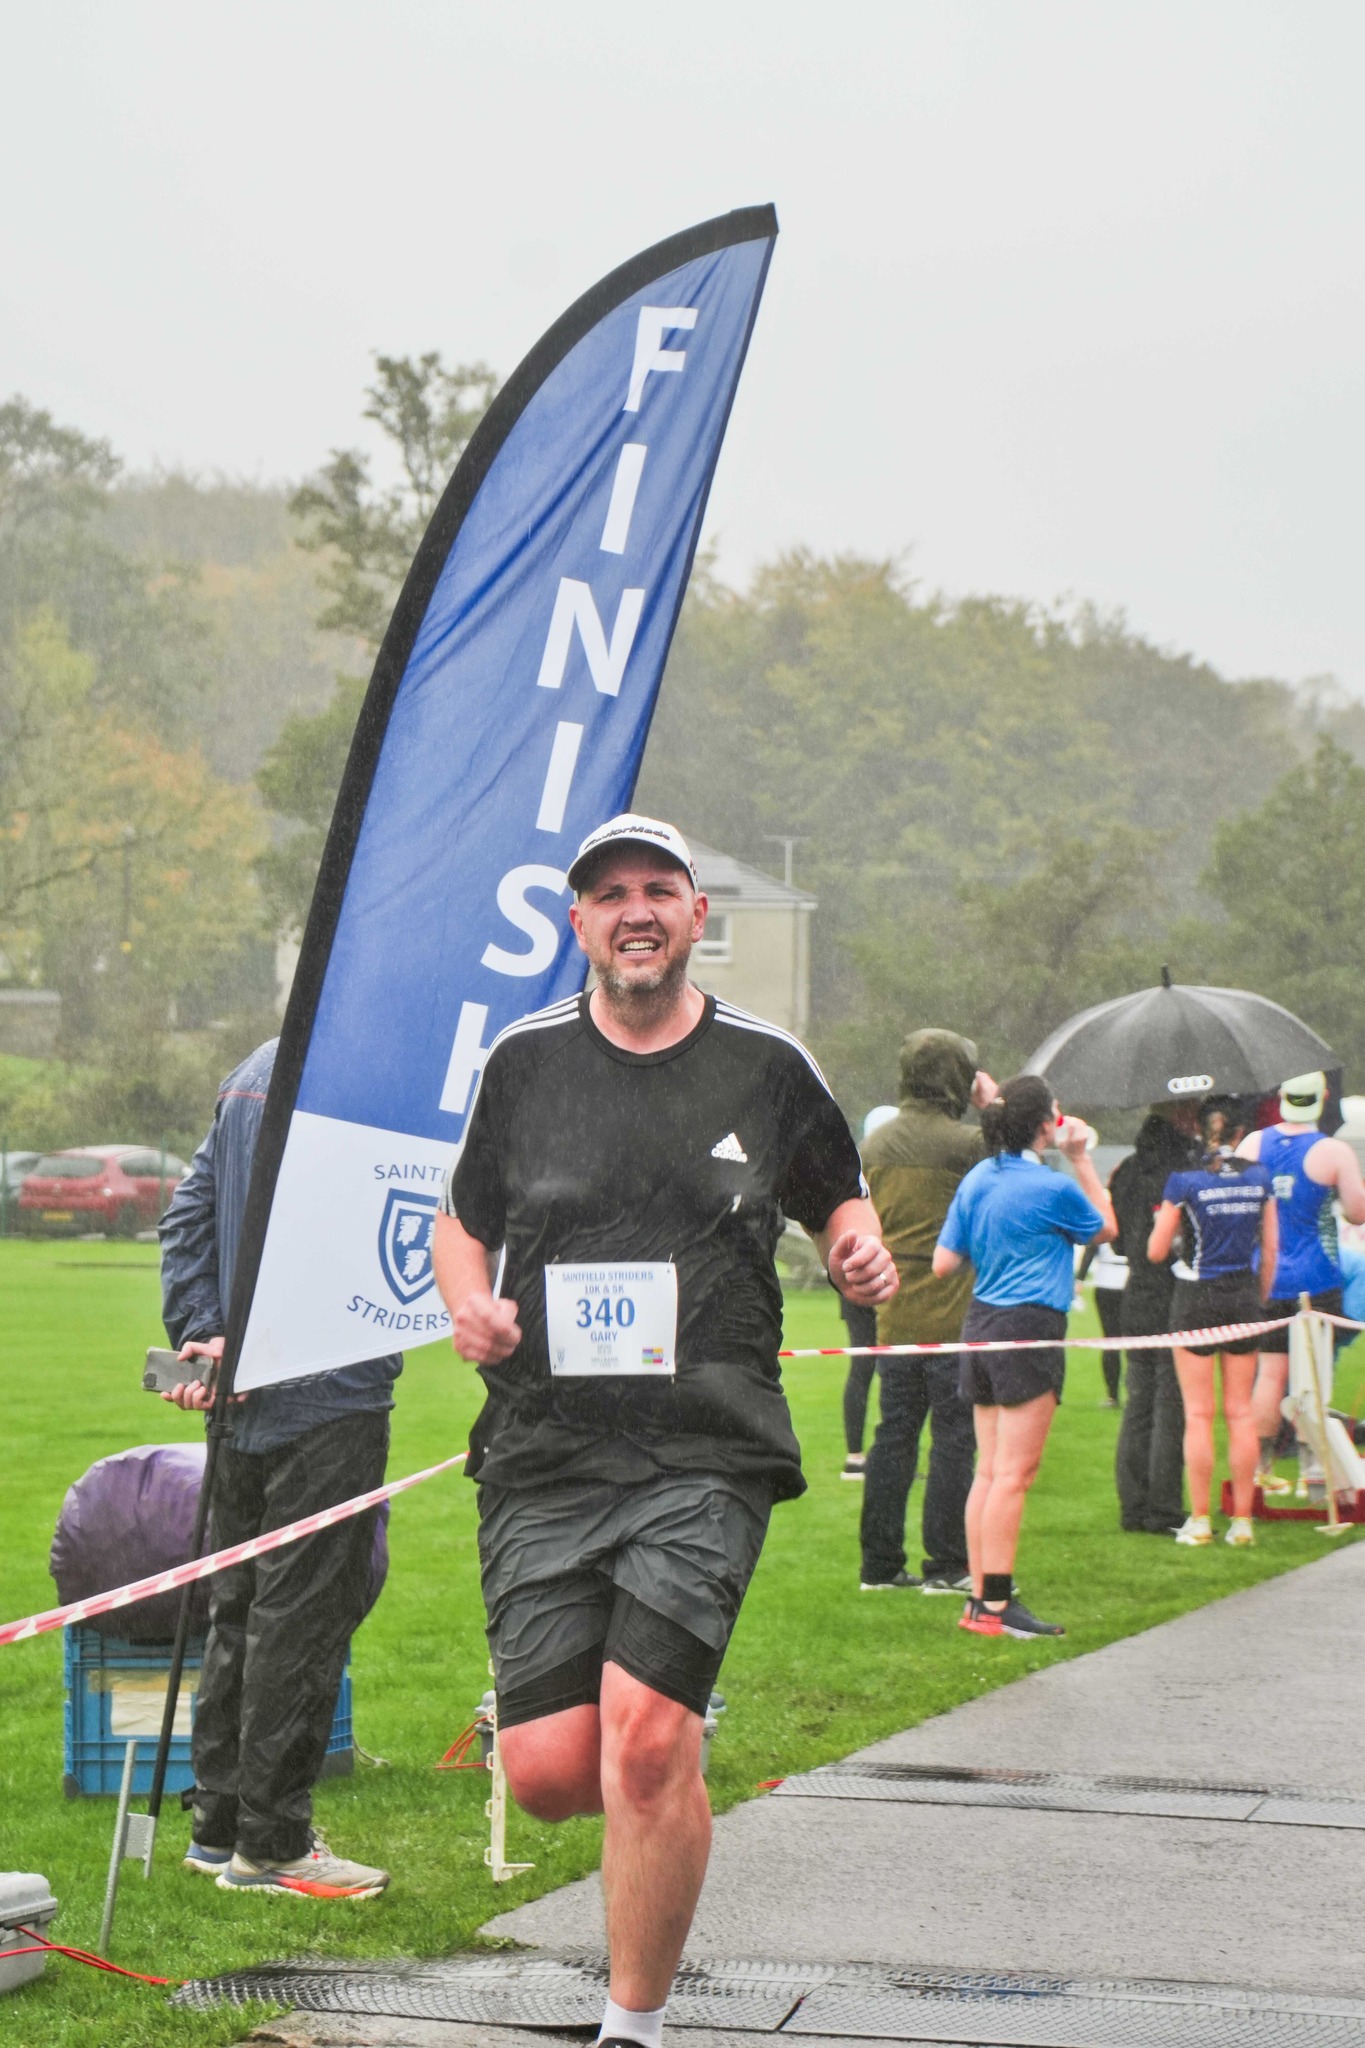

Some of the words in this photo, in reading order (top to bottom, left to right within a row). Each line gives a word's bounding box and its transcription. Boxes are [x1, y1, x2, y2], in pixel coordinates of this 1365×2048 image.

[562, 1271, 606, 1282] SAINTFIELD
[609, 1270, 654, 1281] STRIDERS
[347, 1295, 449, 1331] STRIDERS
[576, 1298, 635, 1328] 340
[590, 1331, 618, 1342] GARY
